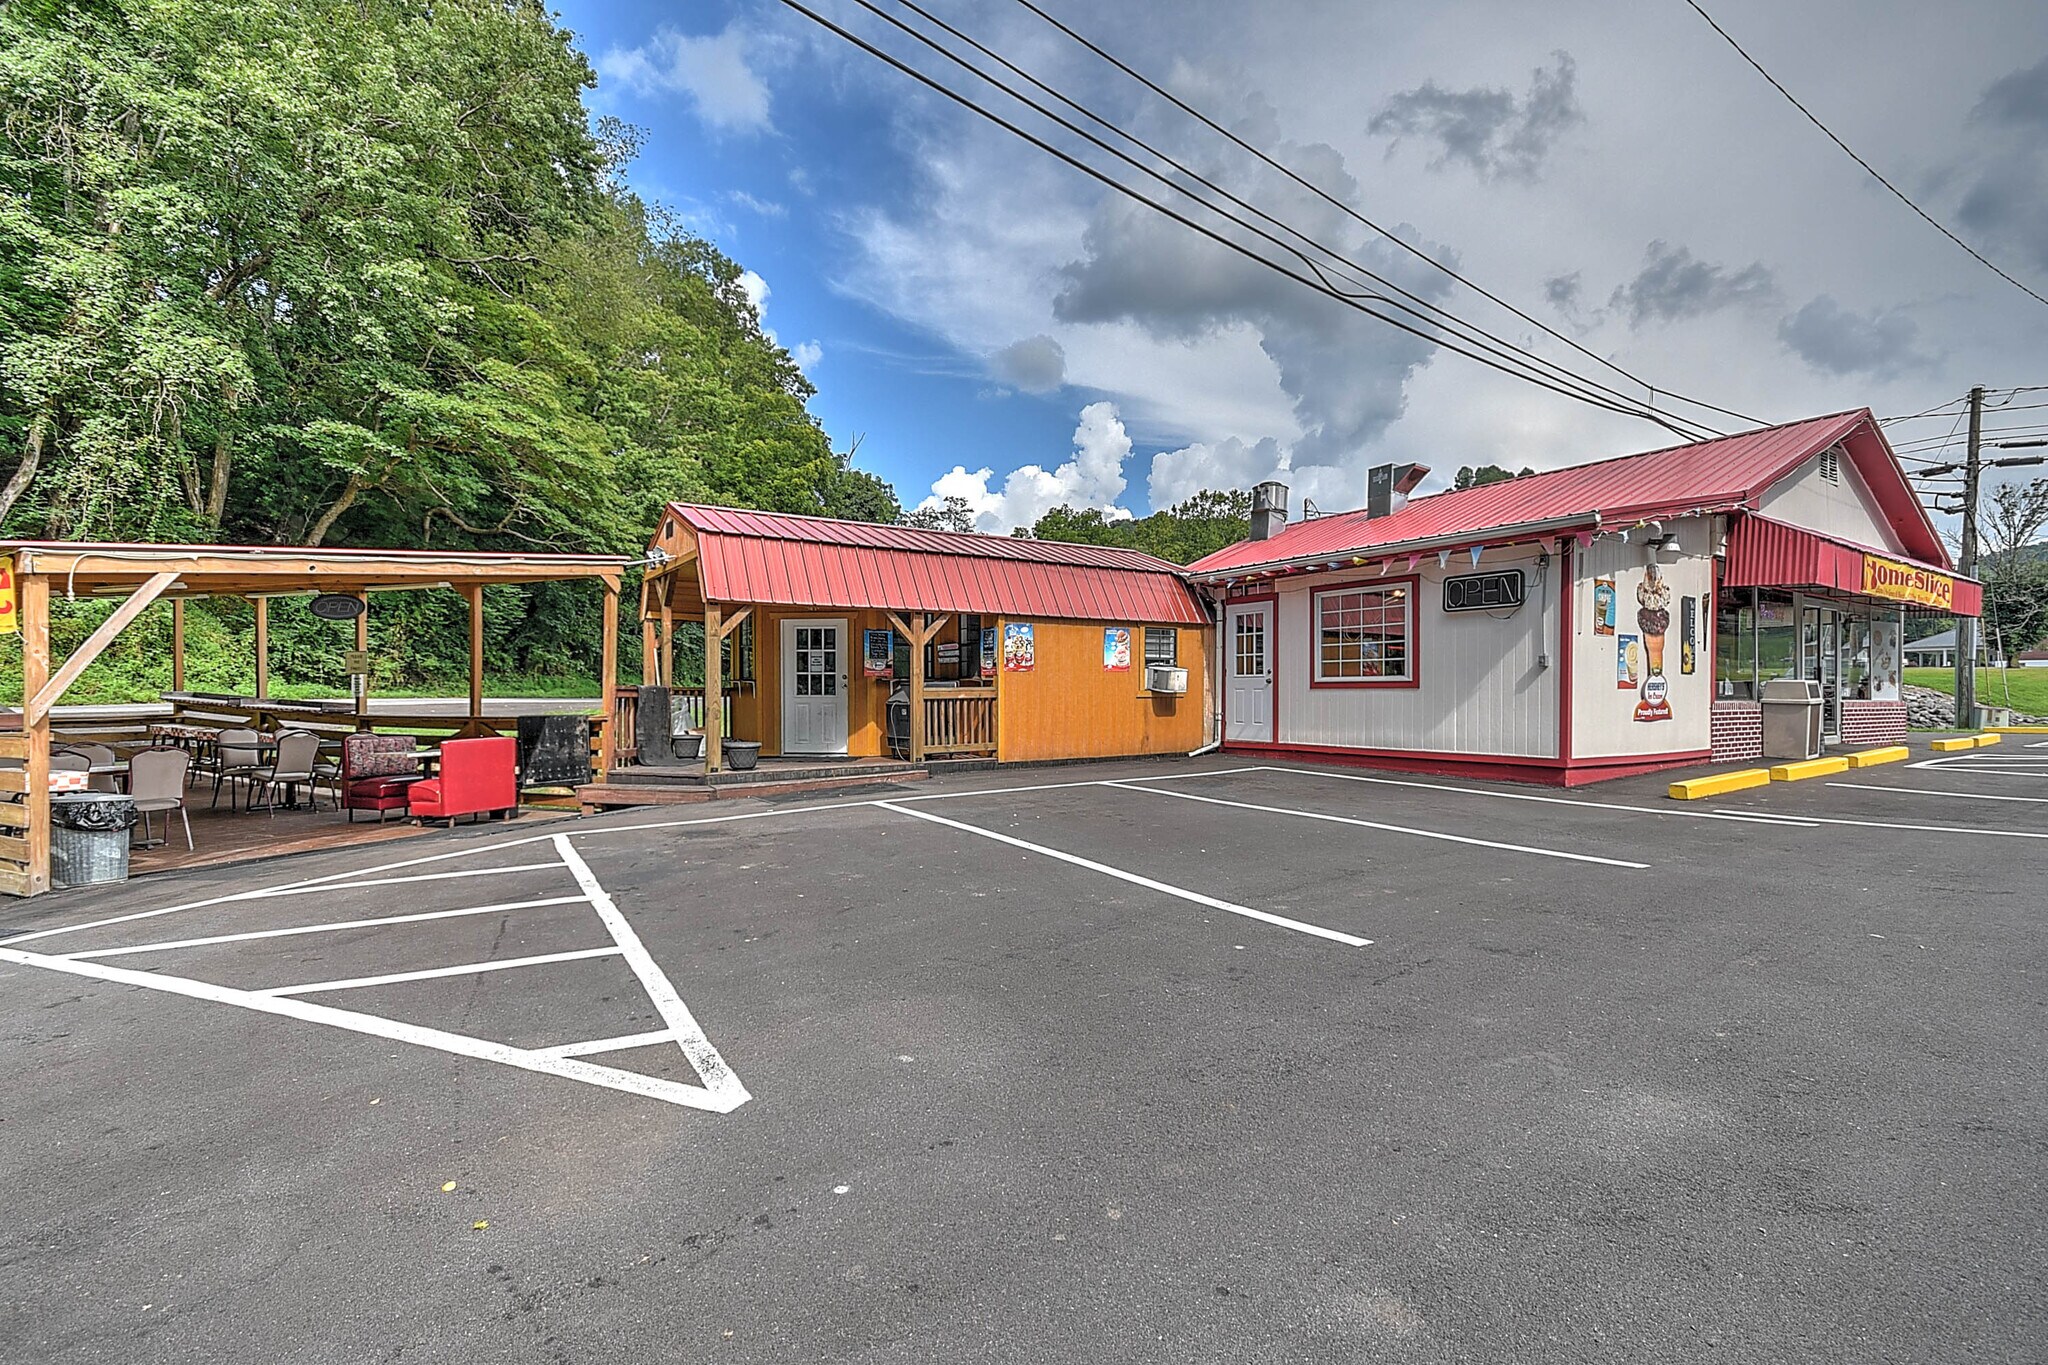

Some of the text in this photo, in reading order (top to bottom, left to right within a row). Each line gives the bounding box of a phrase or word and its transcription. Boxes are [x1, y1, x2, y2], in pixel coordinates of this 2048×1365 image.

[1448, 576, 1518, 607] OPEN
[315, 601, 360, 613] OPEN
[1637, 708, 1653, 717] Proudly
